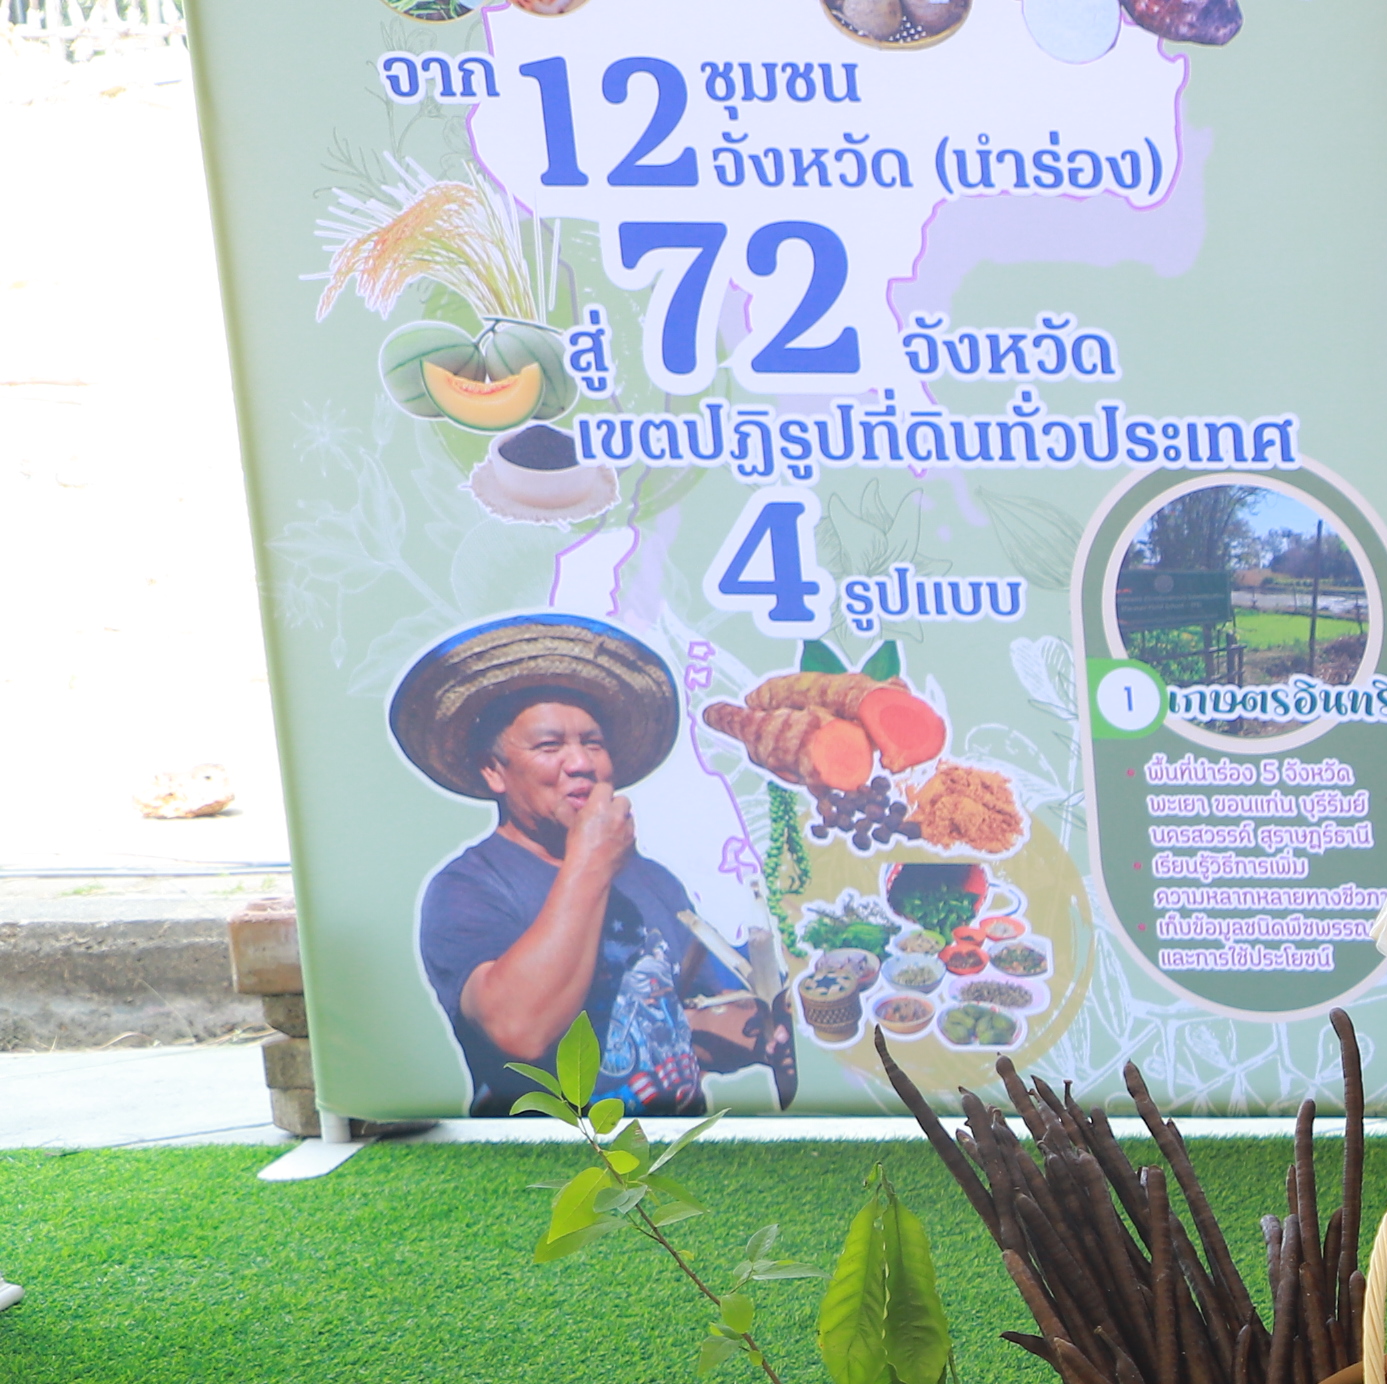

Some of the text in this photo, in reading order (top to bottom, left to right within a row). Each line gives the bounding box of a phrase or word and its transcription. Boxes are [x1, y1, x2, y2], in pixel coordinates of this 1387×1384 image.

[383, 55, 862, 187] จาก 12 ชุมชน
[712, 131, 1164, 196] จังหวัด (นำร่อง)
[568, 220, 1117, 391] สู่ 72 จังหวัด
[579, 389, 1298, 481] เขตปฏิรูปที่ดินทั่วประเทศ
[717, 502, 1023, 624] 4 รูปแบบ
[1122, 685, 1135, 713] 1
[1146, 754, 1354, 785] พื้นที่นำร่อง 5 จังหวัด
[1148, 790, 1370, 820] พะเยา ขอนแก่น บุรีรัมย์
[1150, 824, 1373, 855] นครสวรรค์ สุราษฎร์ธานี
[1153, 853, 1309, 883] เรียนรู้วิธีการเพิ่ม
[1154, 886, 1387, 908] ความหลากหลายทางชีวภา
[1160, 944, 1335, 970] และการใช้ประโยชน์
